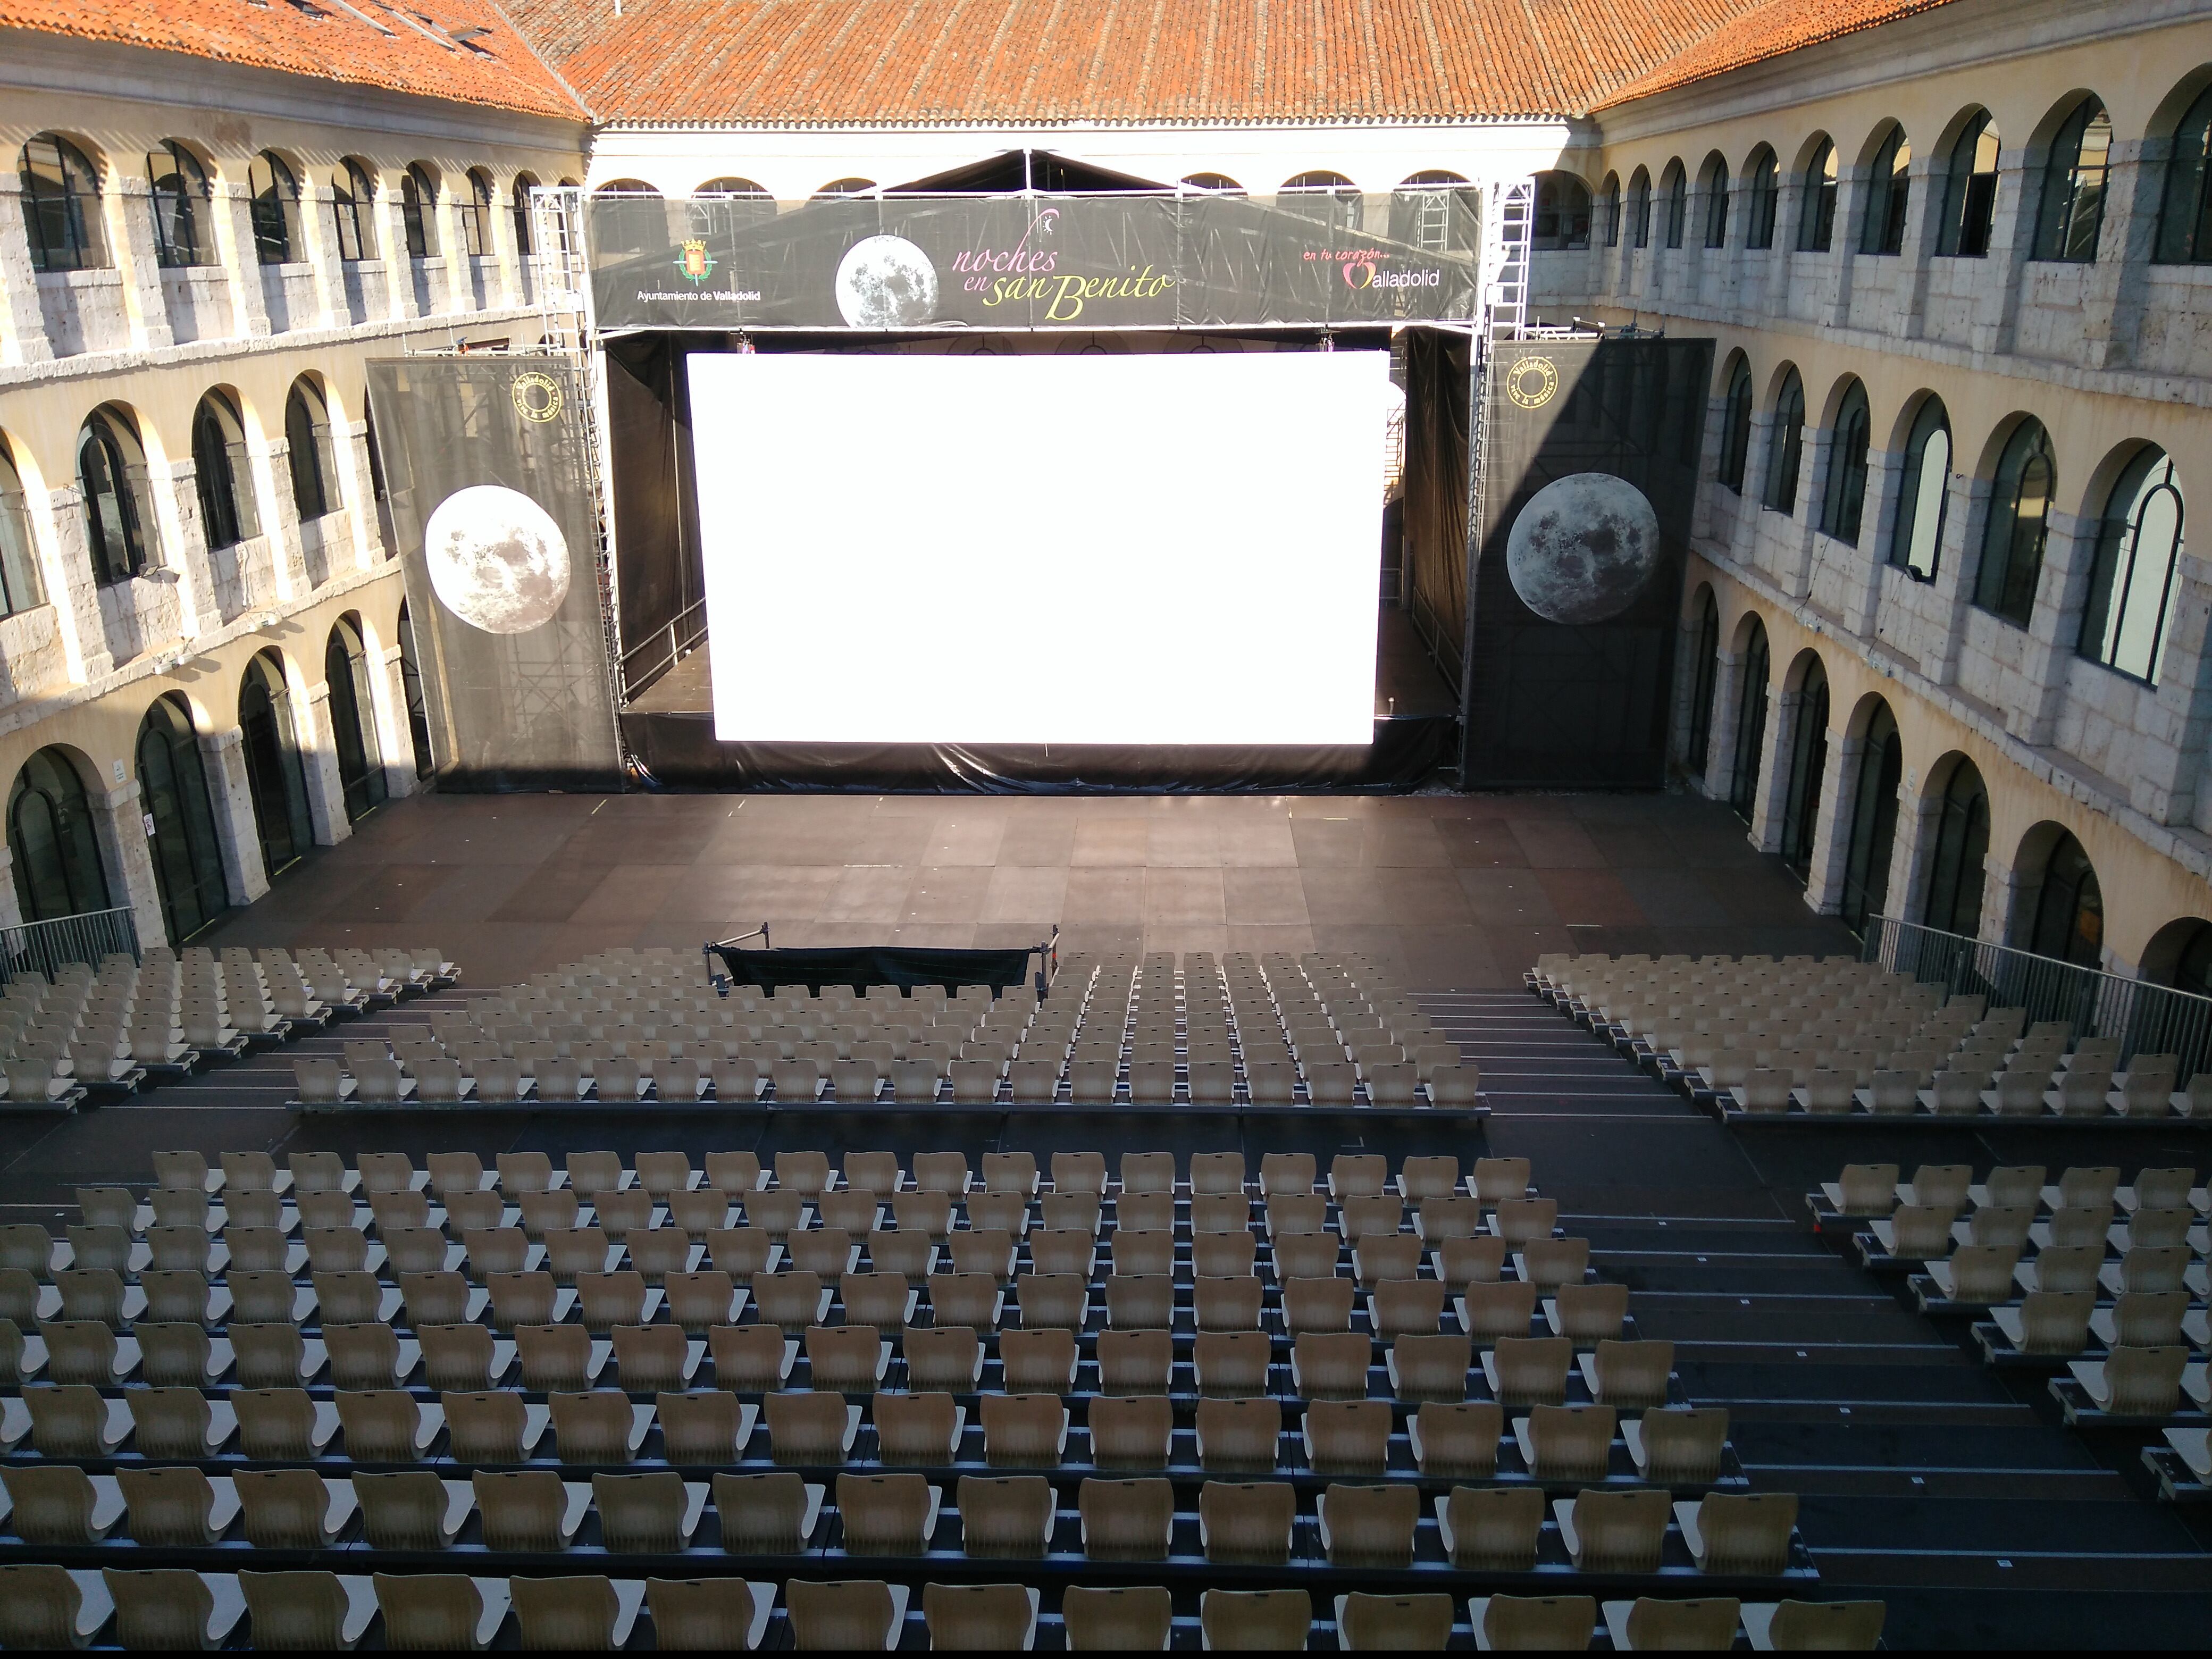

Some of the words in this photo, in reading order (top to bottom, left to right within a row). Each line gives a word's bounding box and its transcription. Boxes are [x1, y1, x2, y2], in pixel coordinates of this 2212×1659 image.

[1303, 250, 1317, 261] en
[1321, 249, 1332, 260] tu
[637, 291, 698, 303] Ayuntamiento
[700, 290, 712, 301] de
[713, 291, 761, 301] Valladolid
[963, 274, 993, 292] en
[982, 275, 1053, 307] san
[1044, 264, 1176, 321] Benito
[1513, 359, 1554, 376] Valladolid
[516, 375, 555, 392] Valladolid
[1510, 384, 1521, 400] vive
[1522, 396, 1529, 405] la
[516, 399, 529, 414] vive
[530, 410, 538, 419] la
